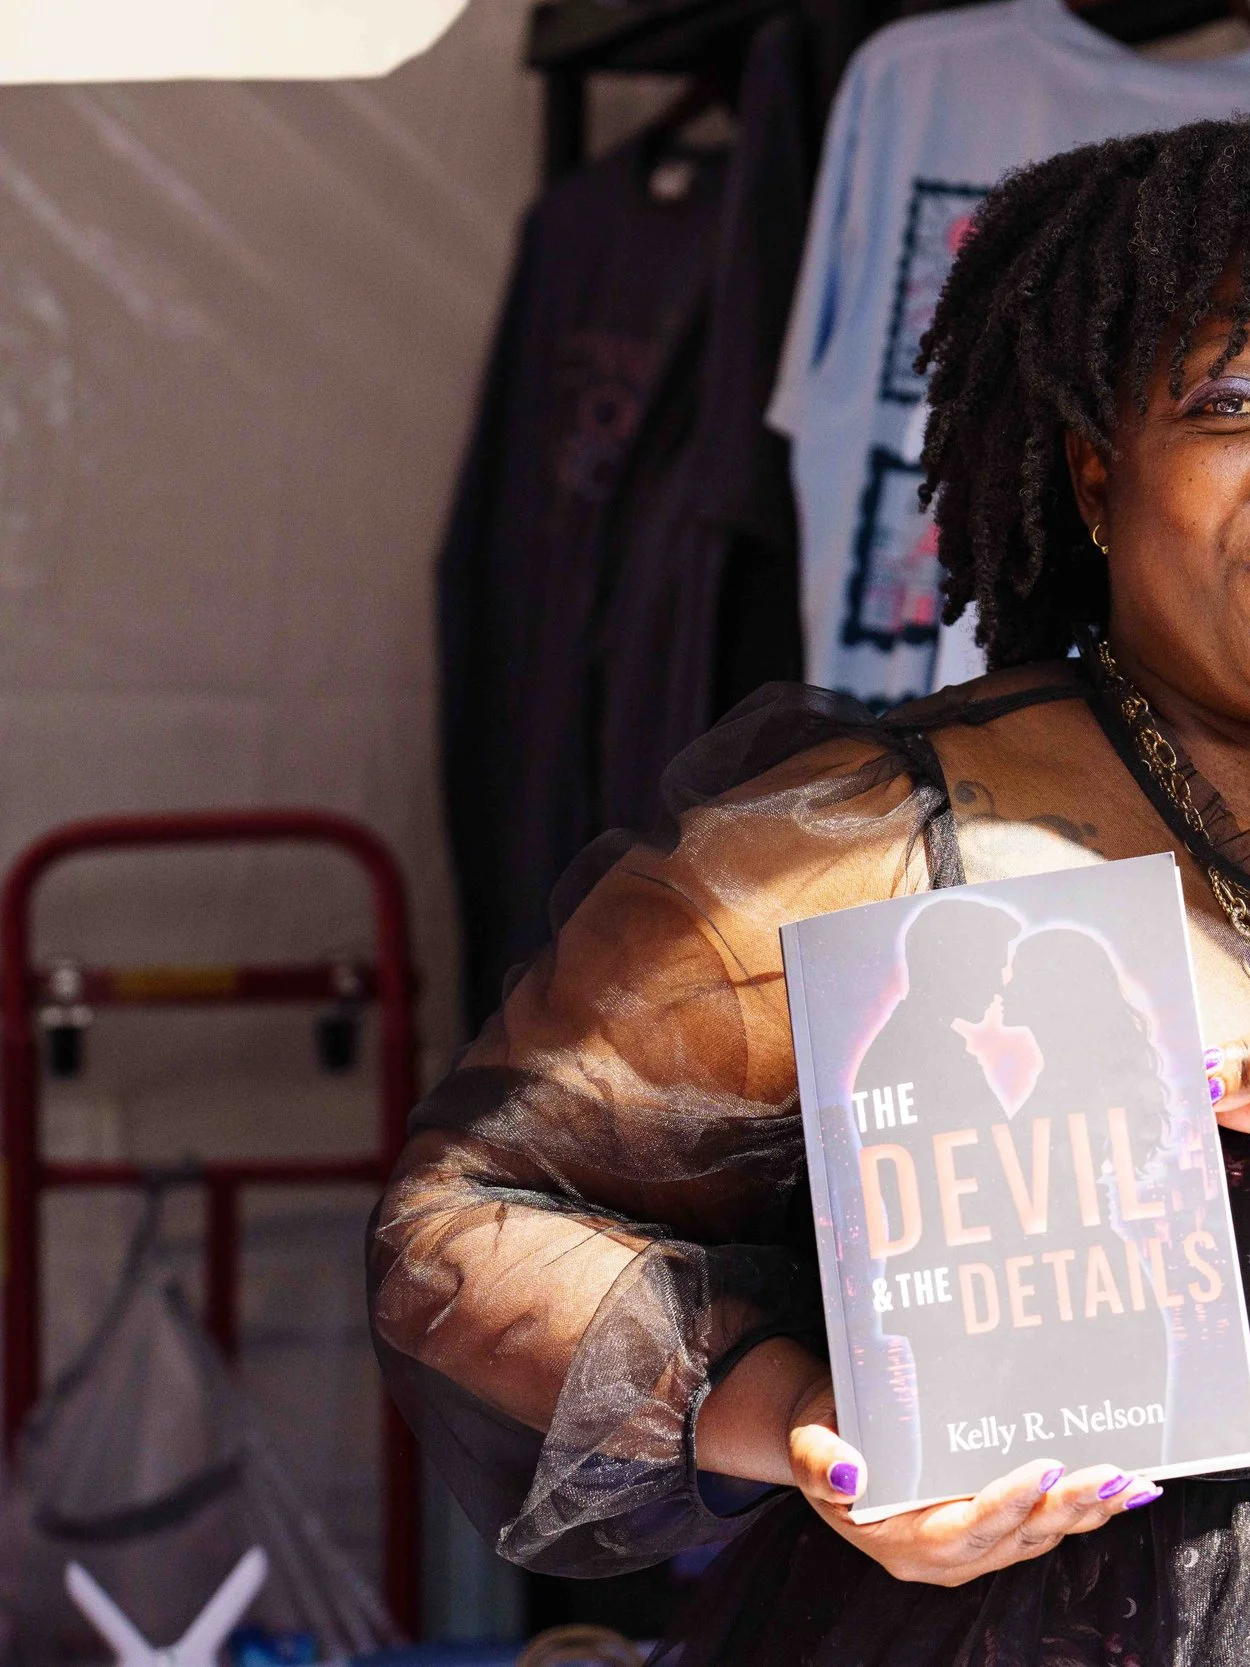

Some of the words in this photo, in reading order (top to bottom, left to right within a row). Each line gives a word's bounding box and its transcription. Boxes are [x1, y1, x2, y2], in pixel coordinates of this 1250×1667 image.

[852, 1082, 918, 1133] THE
[860, 1107, 1165, 1260] DEVIL
[872, 1278, 894, 1313] &
[895, 1266, 953, 1308] THE
[958, 1231, 1223, 1335] DETAILS
[946, 1415, 1016, 1455] Kelly
[1023, 1412, 1055, 1442] R.
[1060, 1399, 1166, 1437] Nelson
